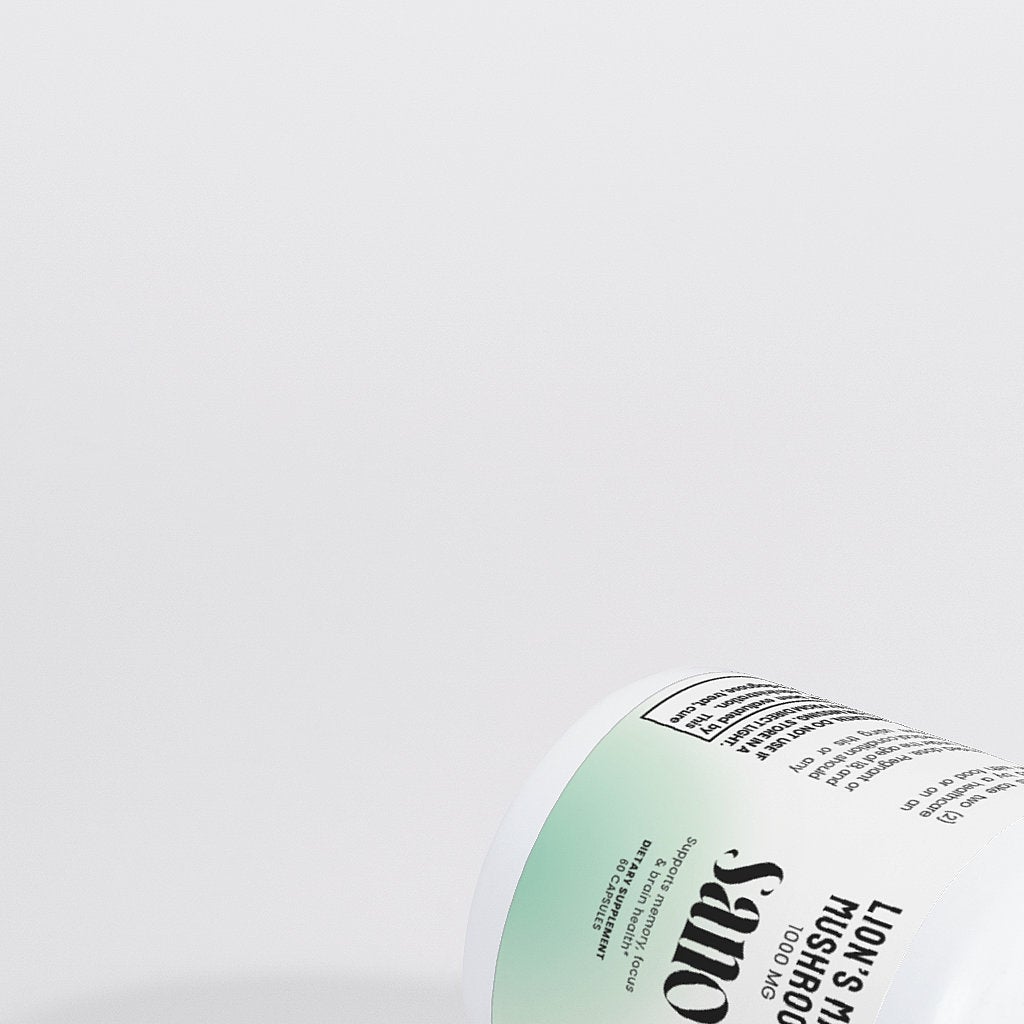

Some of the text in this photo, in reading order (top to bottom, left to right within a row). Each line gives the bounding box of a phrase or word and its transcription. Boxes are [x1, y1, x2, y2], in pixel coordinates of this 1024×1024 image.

[669, 705, 697, 724] cure
[685, 712, 714, 729] This
[754, 706, 797, 728] DIRECT
[700, 723, 722, 735] by
[757, 719, 799, 741] STORE
[811, 719, 834, 729] DO
[719, 723, 760, 747] LIGHT.
[789, 725, 817, 740] NOT
[736, 745, 752, 754] A
[746, 737, 762, 748] IN
[764, 737, 792, 753] USE
[817, 746, 832, 755] or
[755, 750, 771, 762] IF
[862, 754, 878, 763] of
[788, 757, 815, 774] any
[808, 754, 848, 780] should
[845, 760, 869, 770] 18,
[857, 755, 913, 782] Pregnant
[825, 768, 851, 787] and
[938, 778, 954, 787] or
[844, 781, 860, 792] or
[919, 787, 938, 798] on
[900, 799, 920, 811] an
[919, 781, 985, 818] healthcare
[959, 794, 987, 808] two
[936, 810, 964, 825] (2)
[657, 858, 668, 868] &
[592, 858, 629, 931] 60 CAPSULES
[640, 868, 662, 906] brain
[596, 839, 652, 960] DIETARY SUPPLEMENT
[625, 836, 698, 993] Supports memory, focus
[832, 899, 903, 994] LION'S
[761, 924, 804, 1001] 1000 MG
